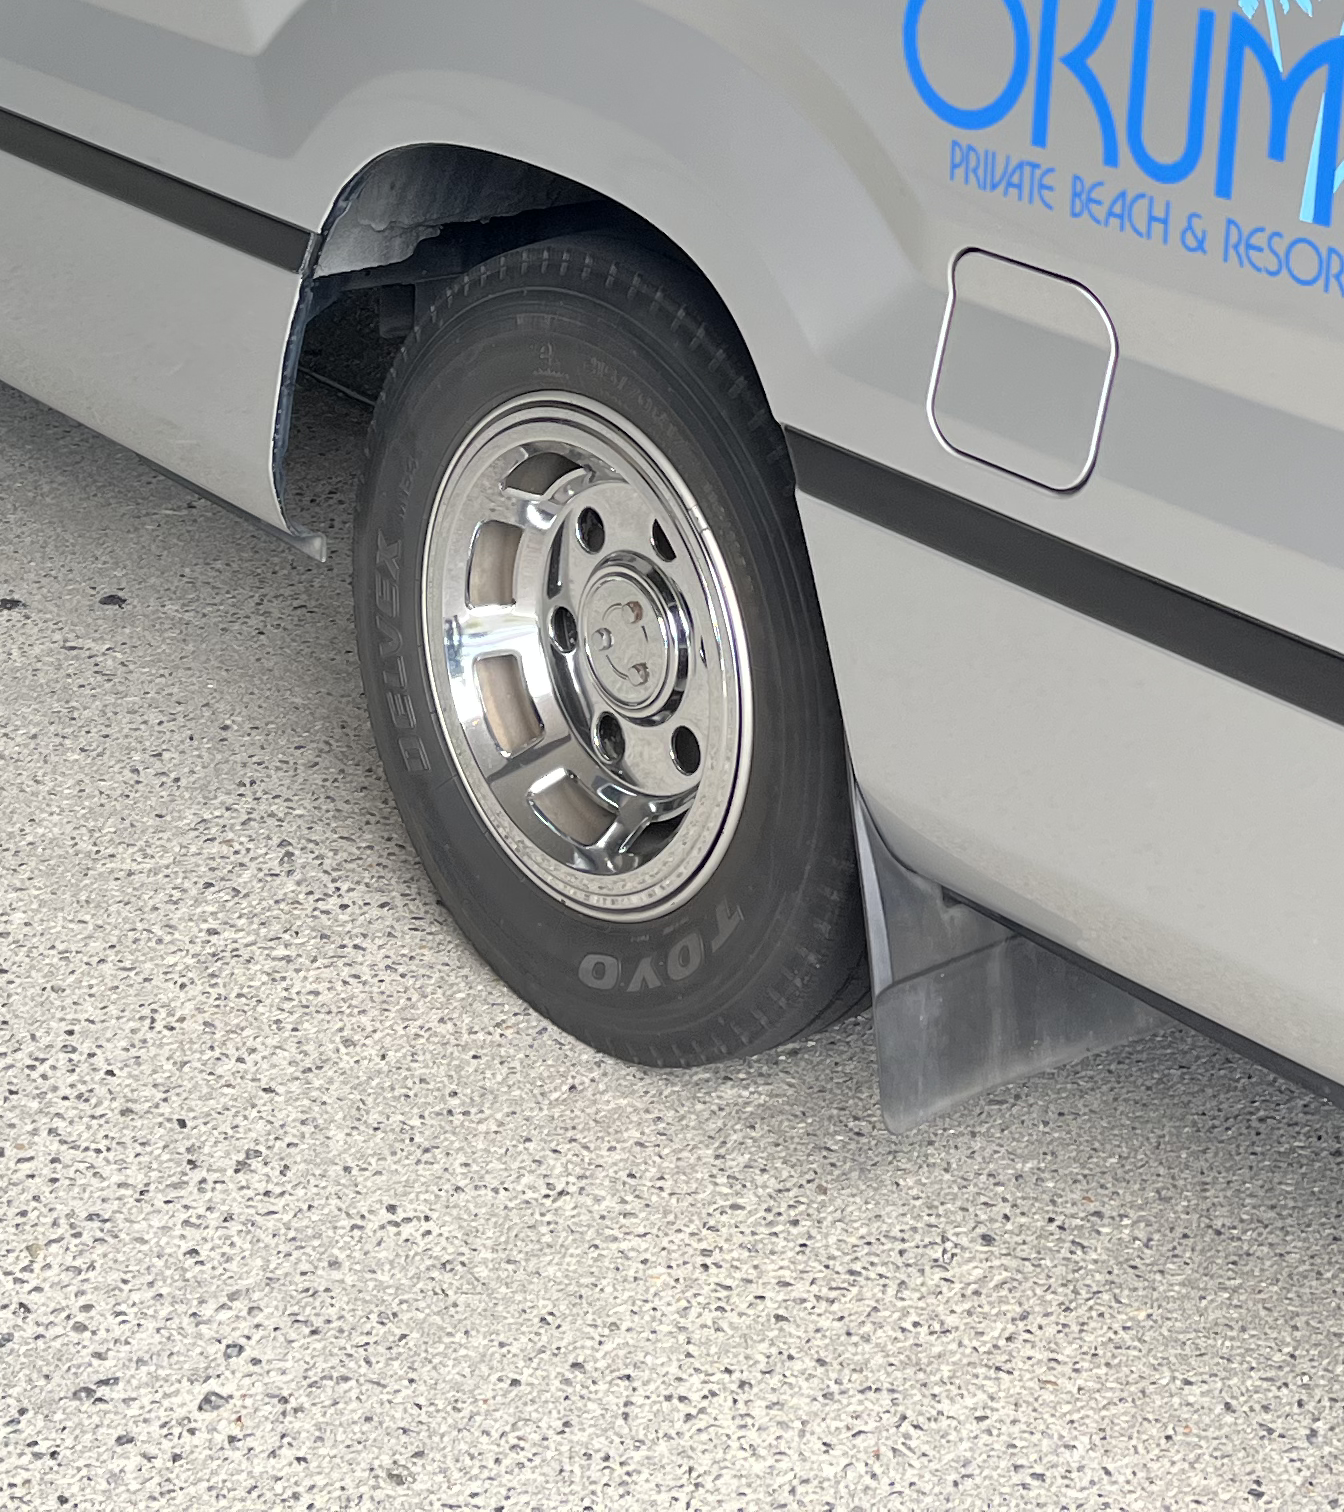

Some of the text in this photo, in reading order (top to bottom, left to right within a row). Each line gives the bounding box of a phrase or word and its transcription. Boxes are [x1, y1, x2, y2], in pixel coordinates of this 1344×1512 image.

[950, 140, 1055, 212] PRIVATE
[1069, 173, 1171, 246] BEACH
[1180, 211, 1208, 255] &
[373, 528, 432, 774] DELVEX
[578, 895, 745, 993] TOYO
